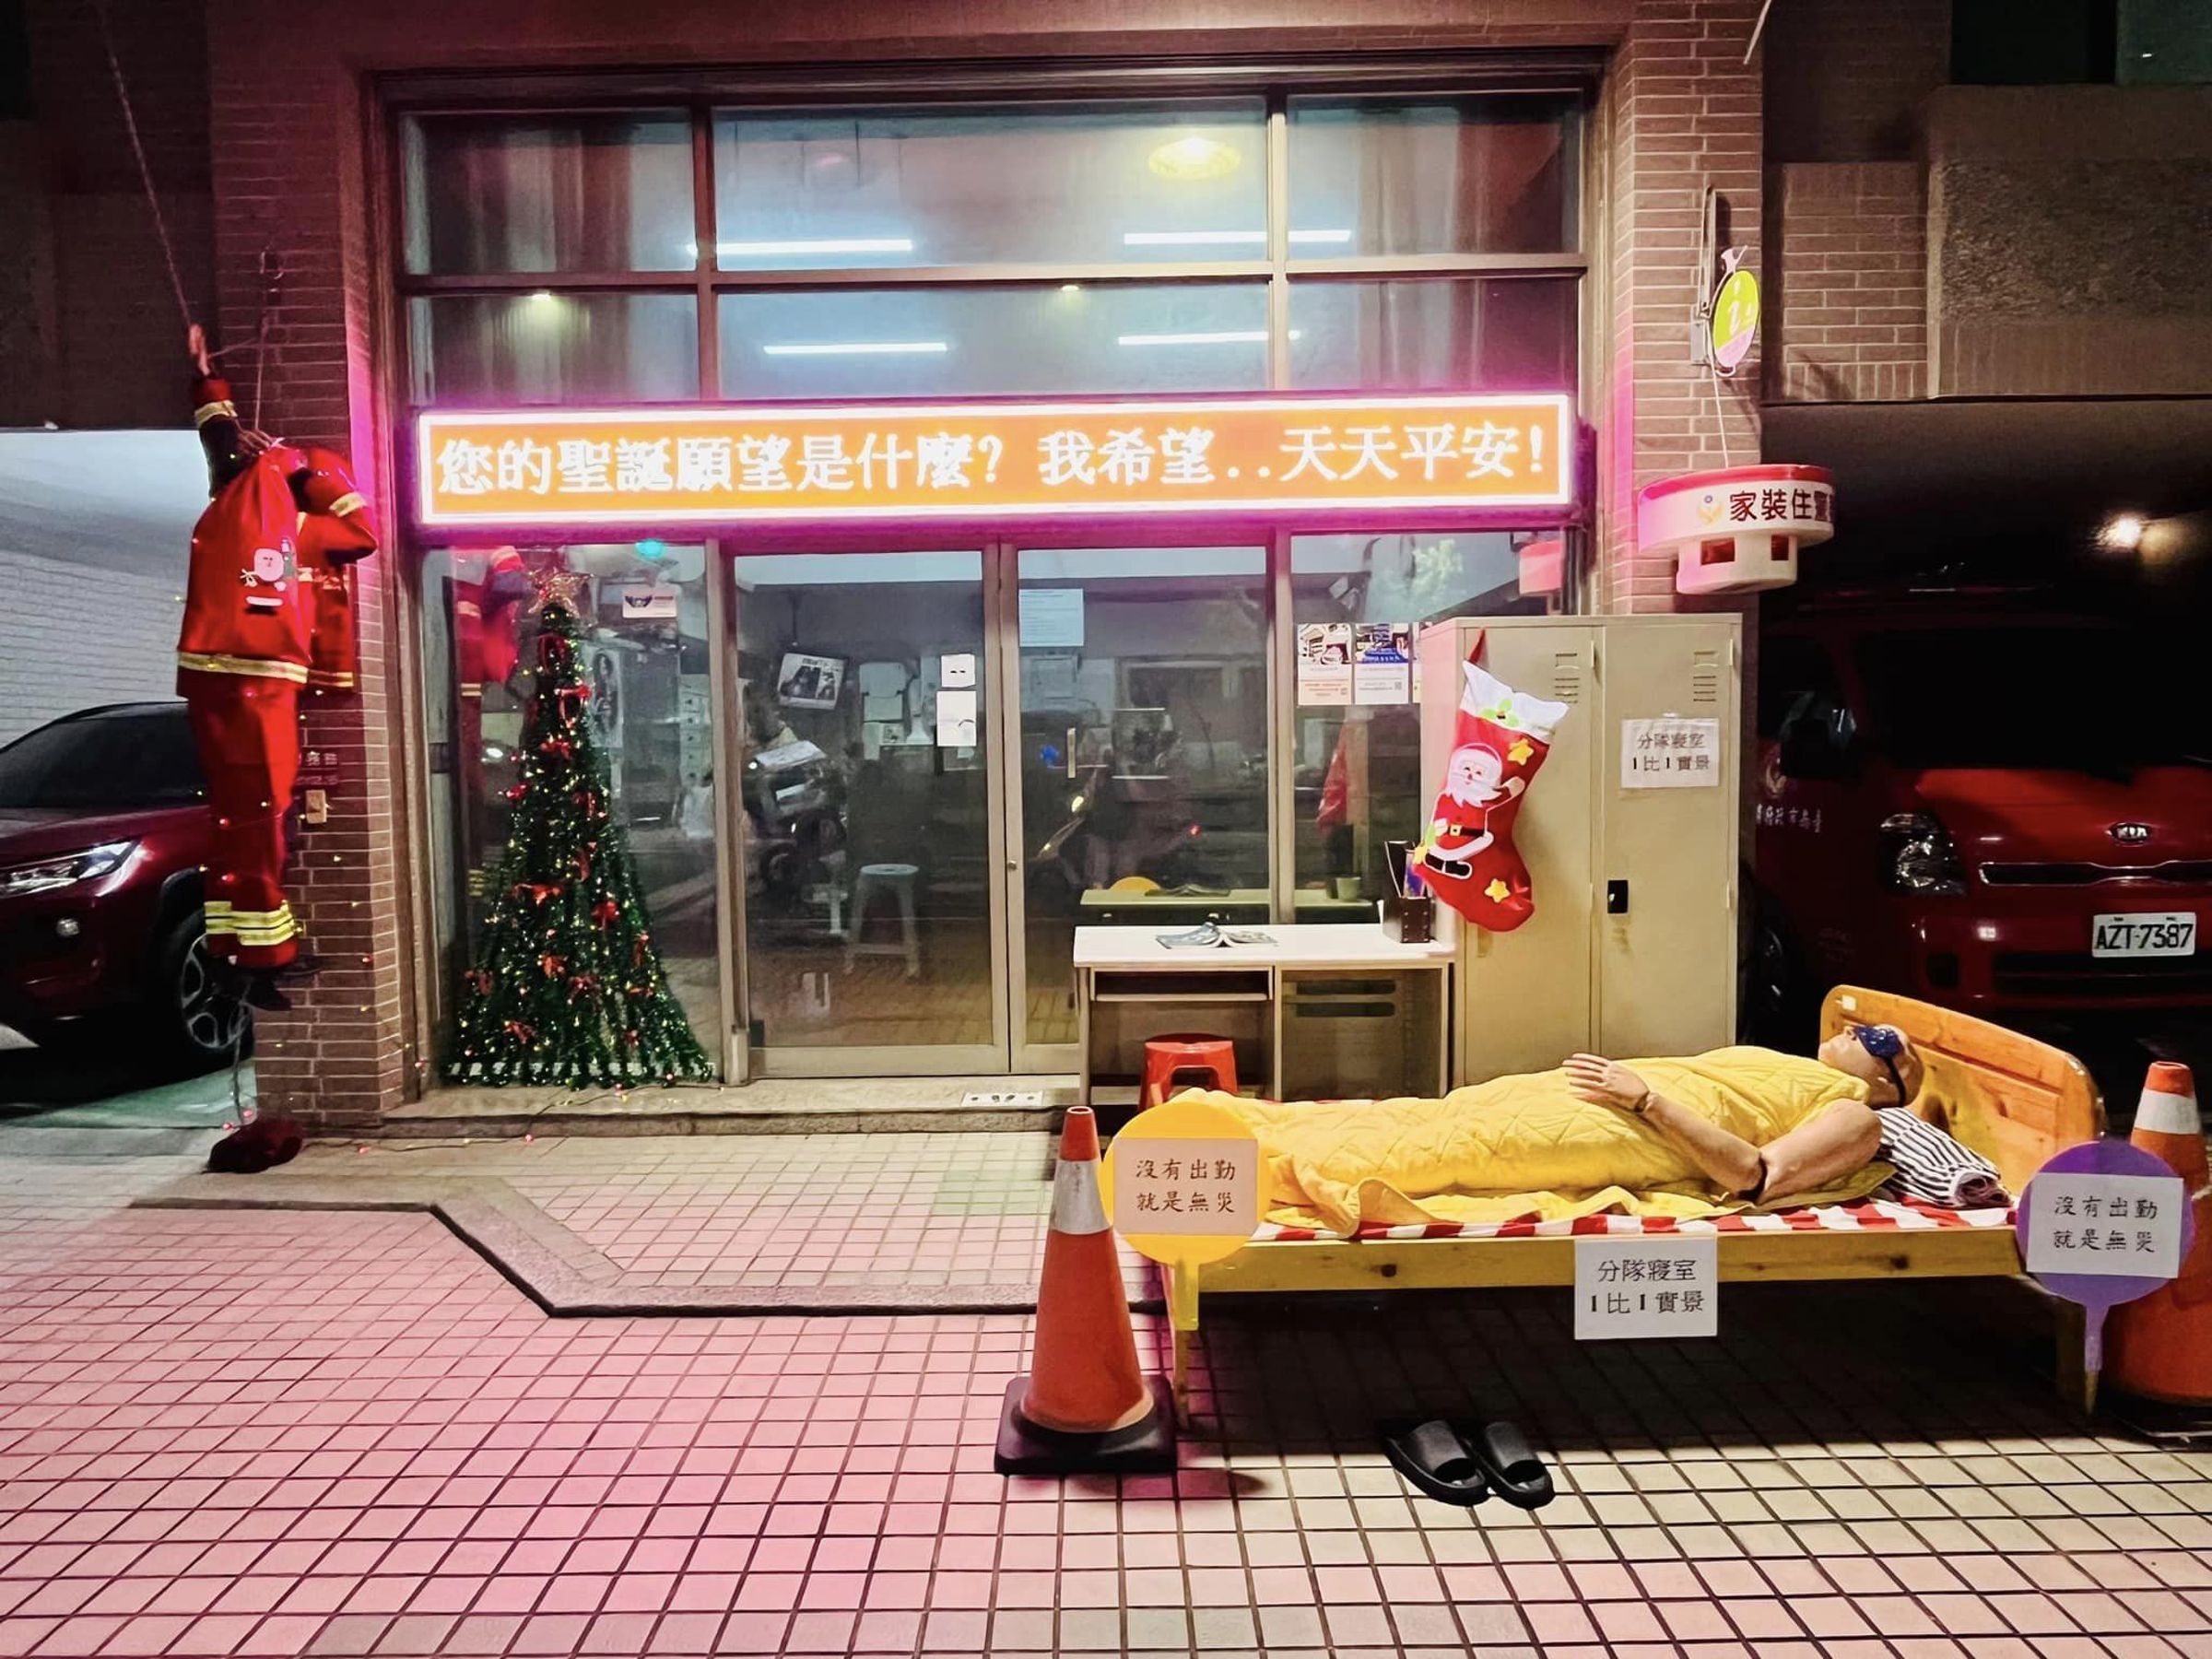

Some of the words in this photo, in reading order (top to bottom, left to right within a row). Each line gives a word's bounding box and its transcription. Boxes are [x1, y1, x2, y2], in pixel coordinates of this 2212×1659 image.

[437, 430, 1003, 495] 您的聖誕願望是什麼?
[1729, 488, 1833, 523] 家裝住
[2095, 924, 2194, 949] AZT-7387
[1135, 1159, 1236, 1181] 沒有出勤
[1136, 1191, 1236, 1213] 就是無災
[1597, 1259, 1697, 1282] 分隊寢室
